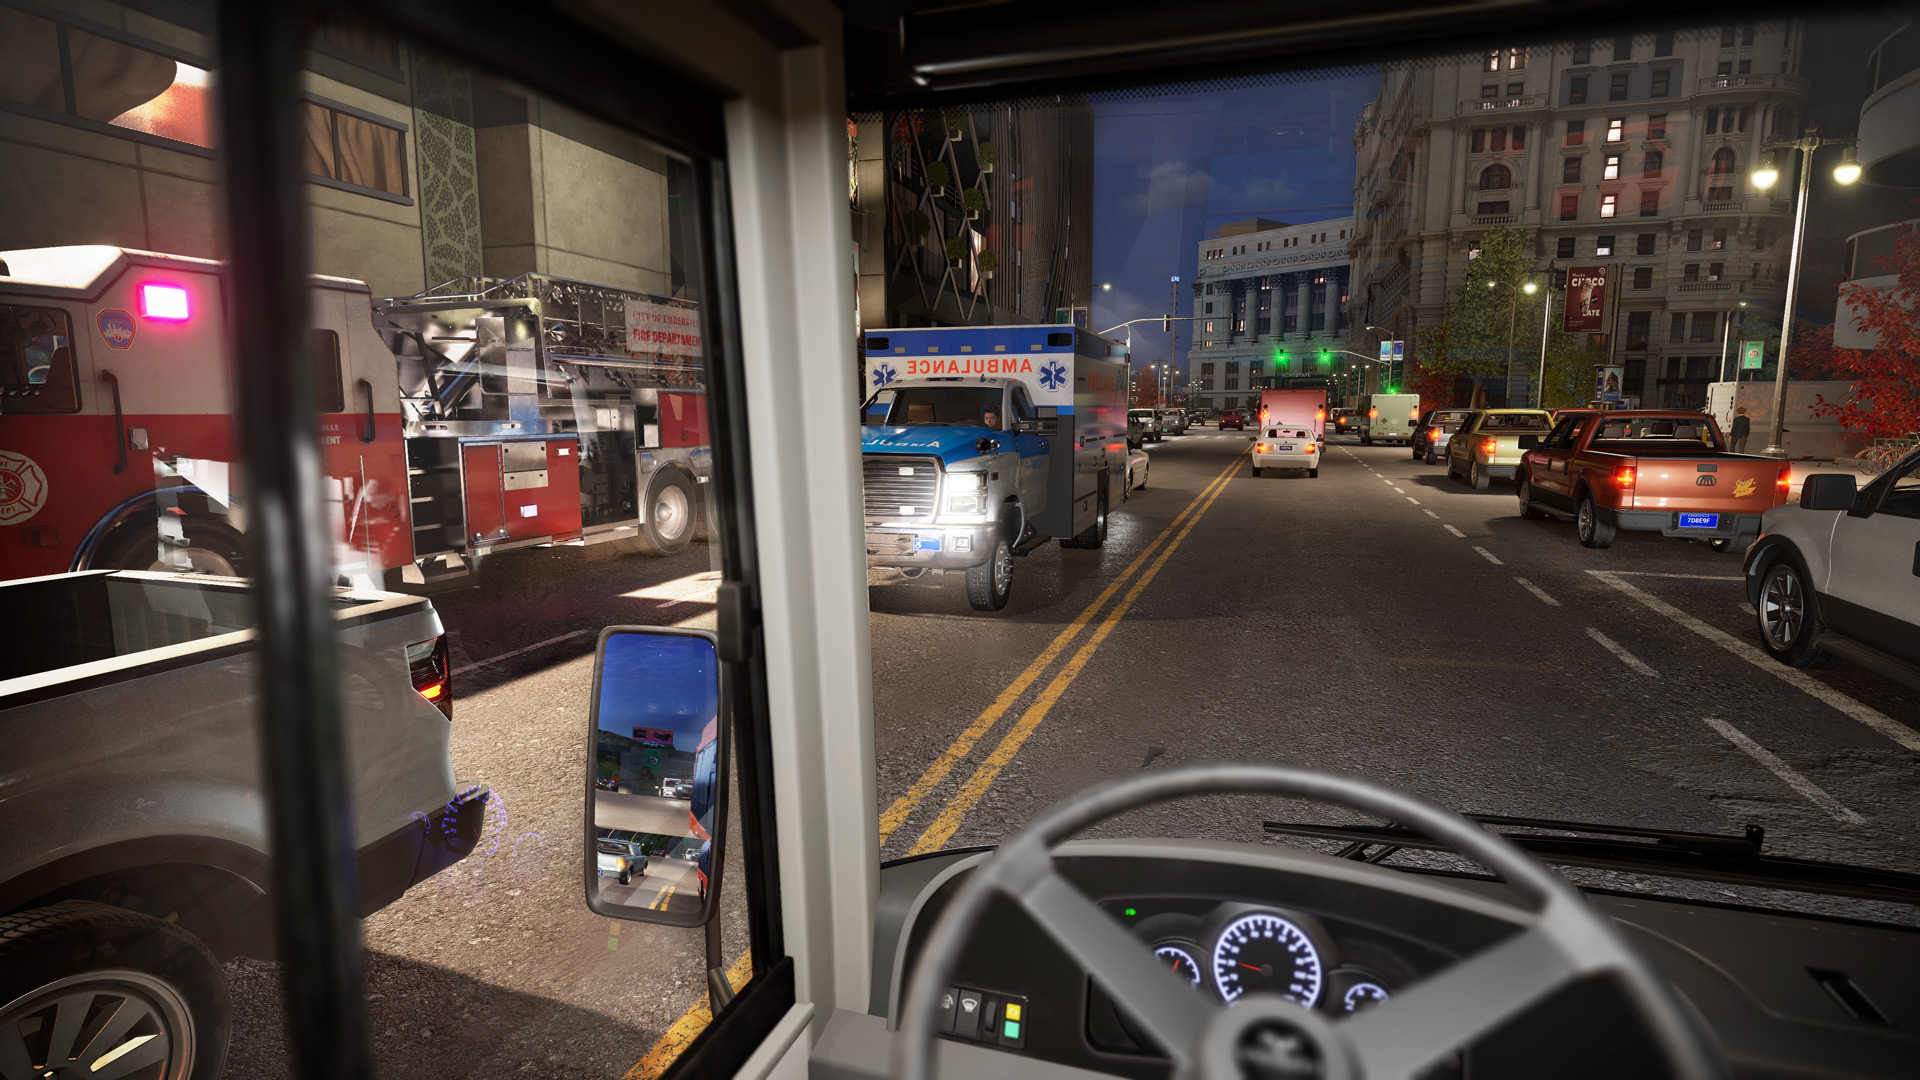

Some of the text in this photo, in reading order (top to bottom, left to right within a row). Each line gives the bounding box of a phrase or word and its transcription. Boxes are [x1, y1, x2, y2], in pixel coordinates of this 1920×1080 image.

[632, 310, 701, 329] CITY OF EMBERVILL
[632, 328, 702, 347] FIRE DEPARTAMEN
